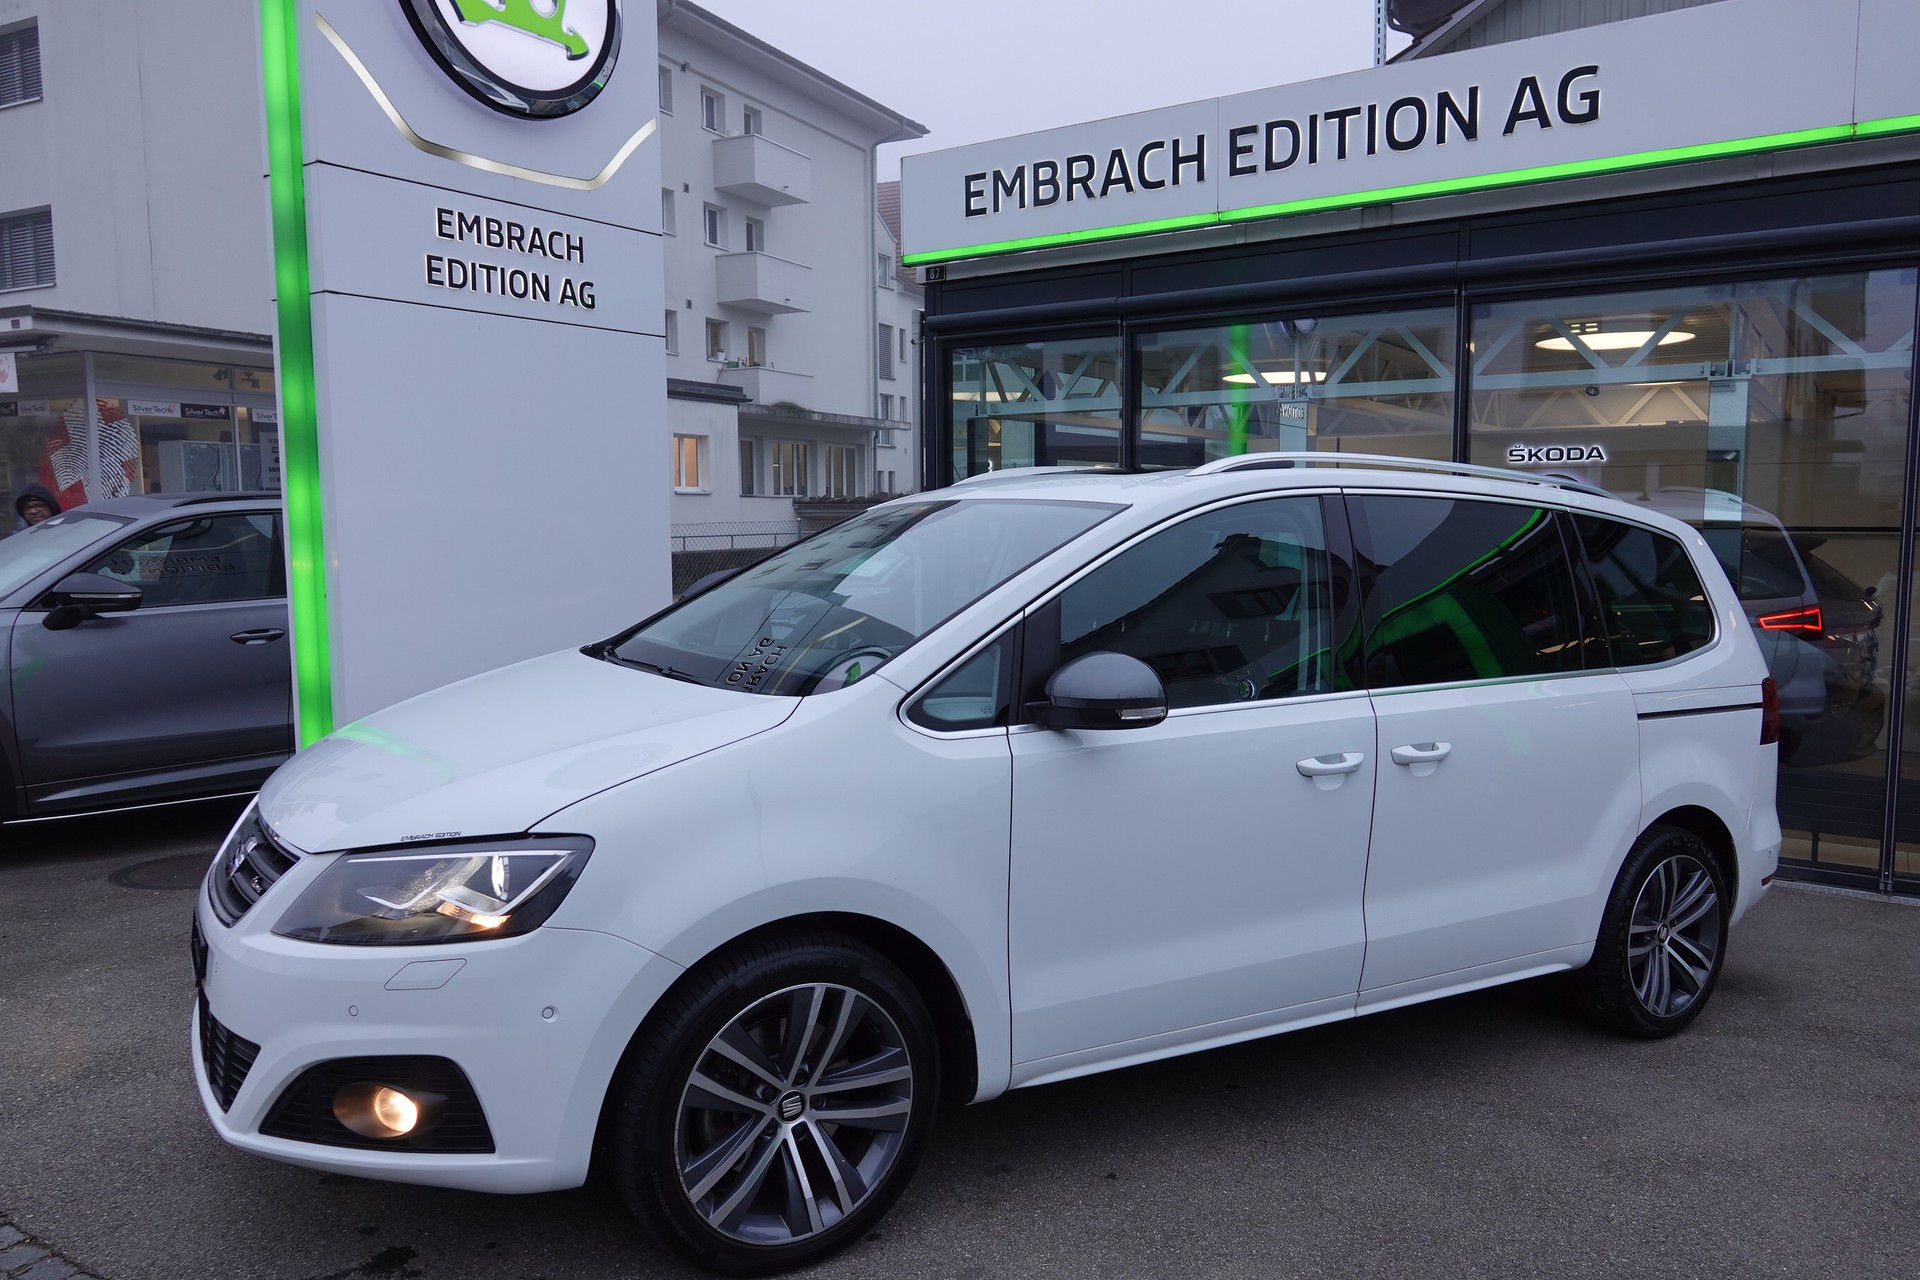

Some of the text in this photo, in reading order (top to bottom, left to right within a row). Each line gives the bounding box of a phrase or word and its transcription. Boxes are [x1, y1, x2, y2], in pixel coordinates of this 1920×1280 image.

[964, 64, 1601, 218] EMBRACH EDITION AG
[436, 207, 584, 264] EMBRACH
[425, 254, 596, 310] EDITION AG
[929, 267, 941, 280] 87
[1508, 445, 1606, 462] ŠKODA
